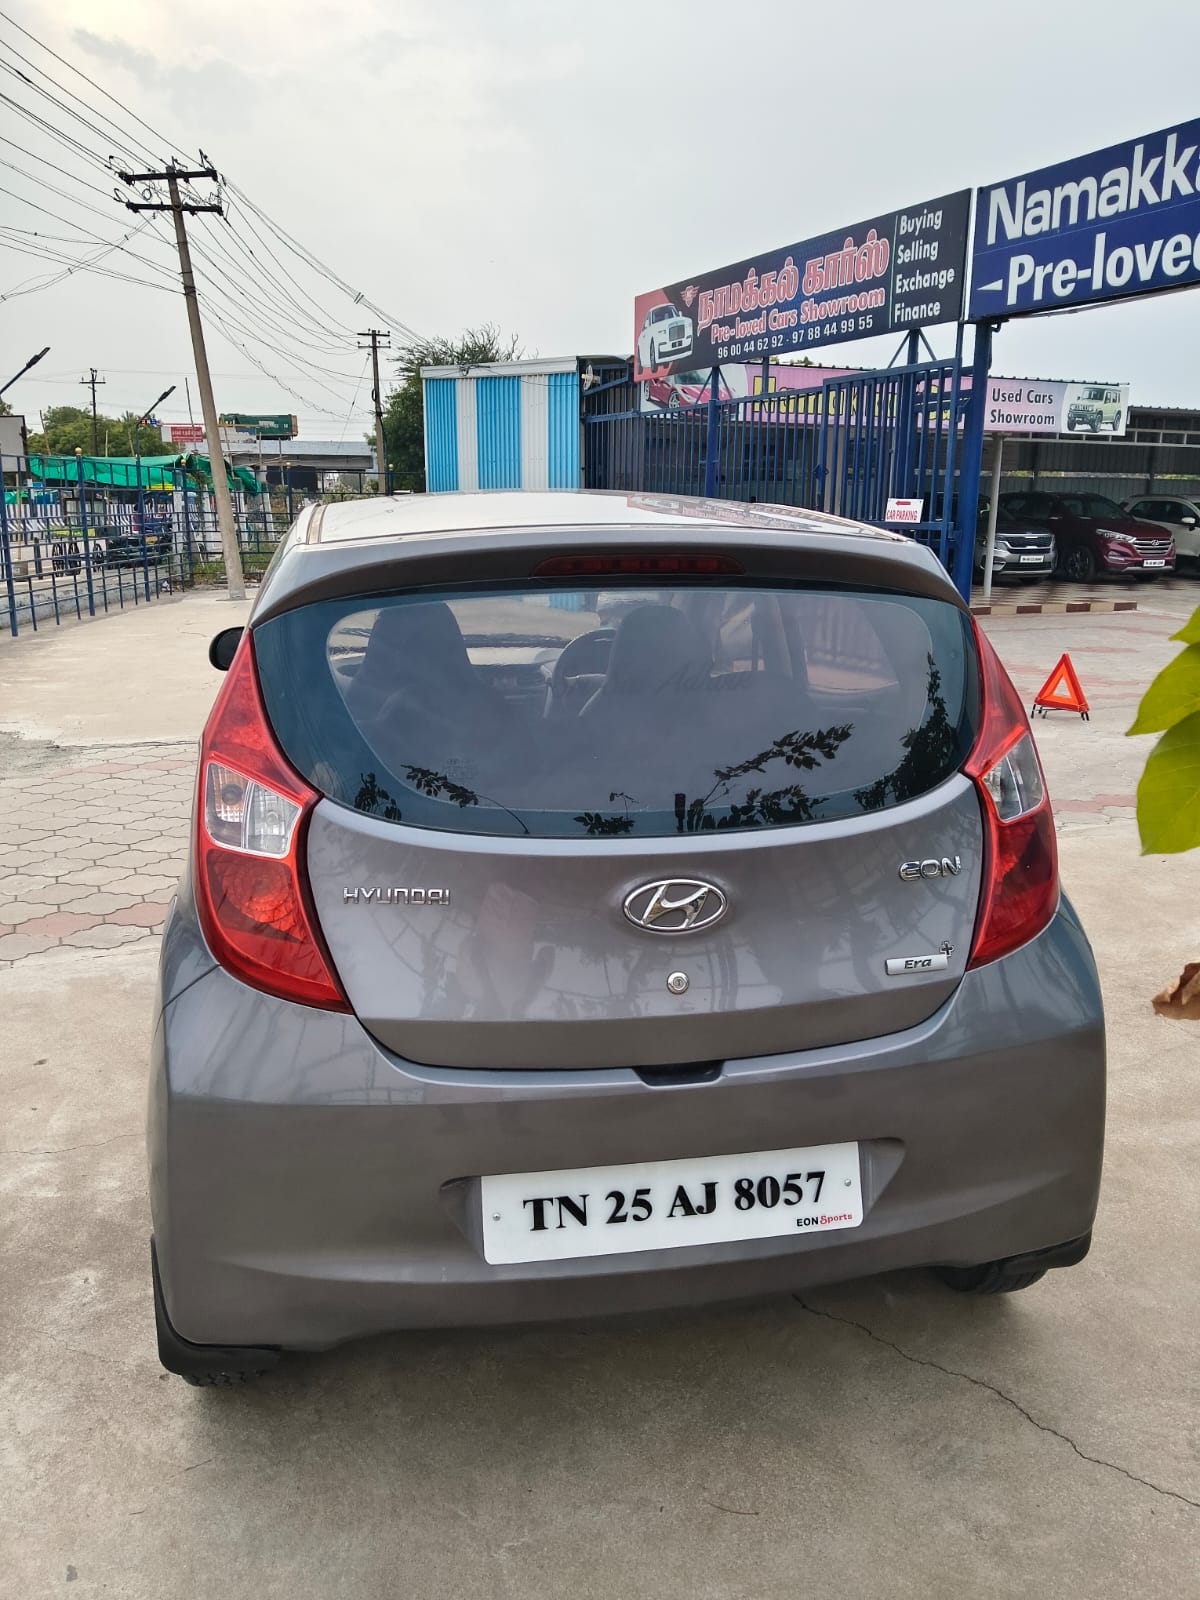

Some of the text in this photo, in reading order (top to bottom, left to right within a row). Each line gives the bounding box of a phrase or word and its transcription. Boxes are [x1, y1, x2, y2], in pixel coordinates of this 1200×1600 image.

[987, 132, 1200, 246] Namakk
[900, 208, 943, 236] Buying
[897, 239, 939, 264] Selling
[895, 268, 955, 294] Exchange
[1006, 232, 1200, 306] Pre-love
[696, 228, 890, 337] நாமக்கல் கார்ஸ்
[711, 287, 886, 345] Pre-loved Cars Showroom
[894, 301, 941, 323] Finance
[717, 346, 729, 359] 96
[730, 343, 742, 357] 00
[743, 340, 755, 353] 44
[757, 337, 769, 350] 62
[771, 334, 784, 348] 92
[792, 330, 804, 344] 97
[807, 326, 821, 341] 88
[823, 322, 837, 337] 44
[840, 319, 855, 334] 99
[858, 315, 873, 330] 55
[992, 387, 1054, 404] Used Cars
[990, 408, 1055, 425] Showroom
[886, 510, 918, 521] CAR PARKING
[899, 855, 962, 881] EON
[342, 886, 451, 906] HYUNDAI
[903, 958, 932, 970] Era
[523, 1170, 826, 1232] TN 25 AJ 8057
[796, 1213, 853, 1227] EON Sports
